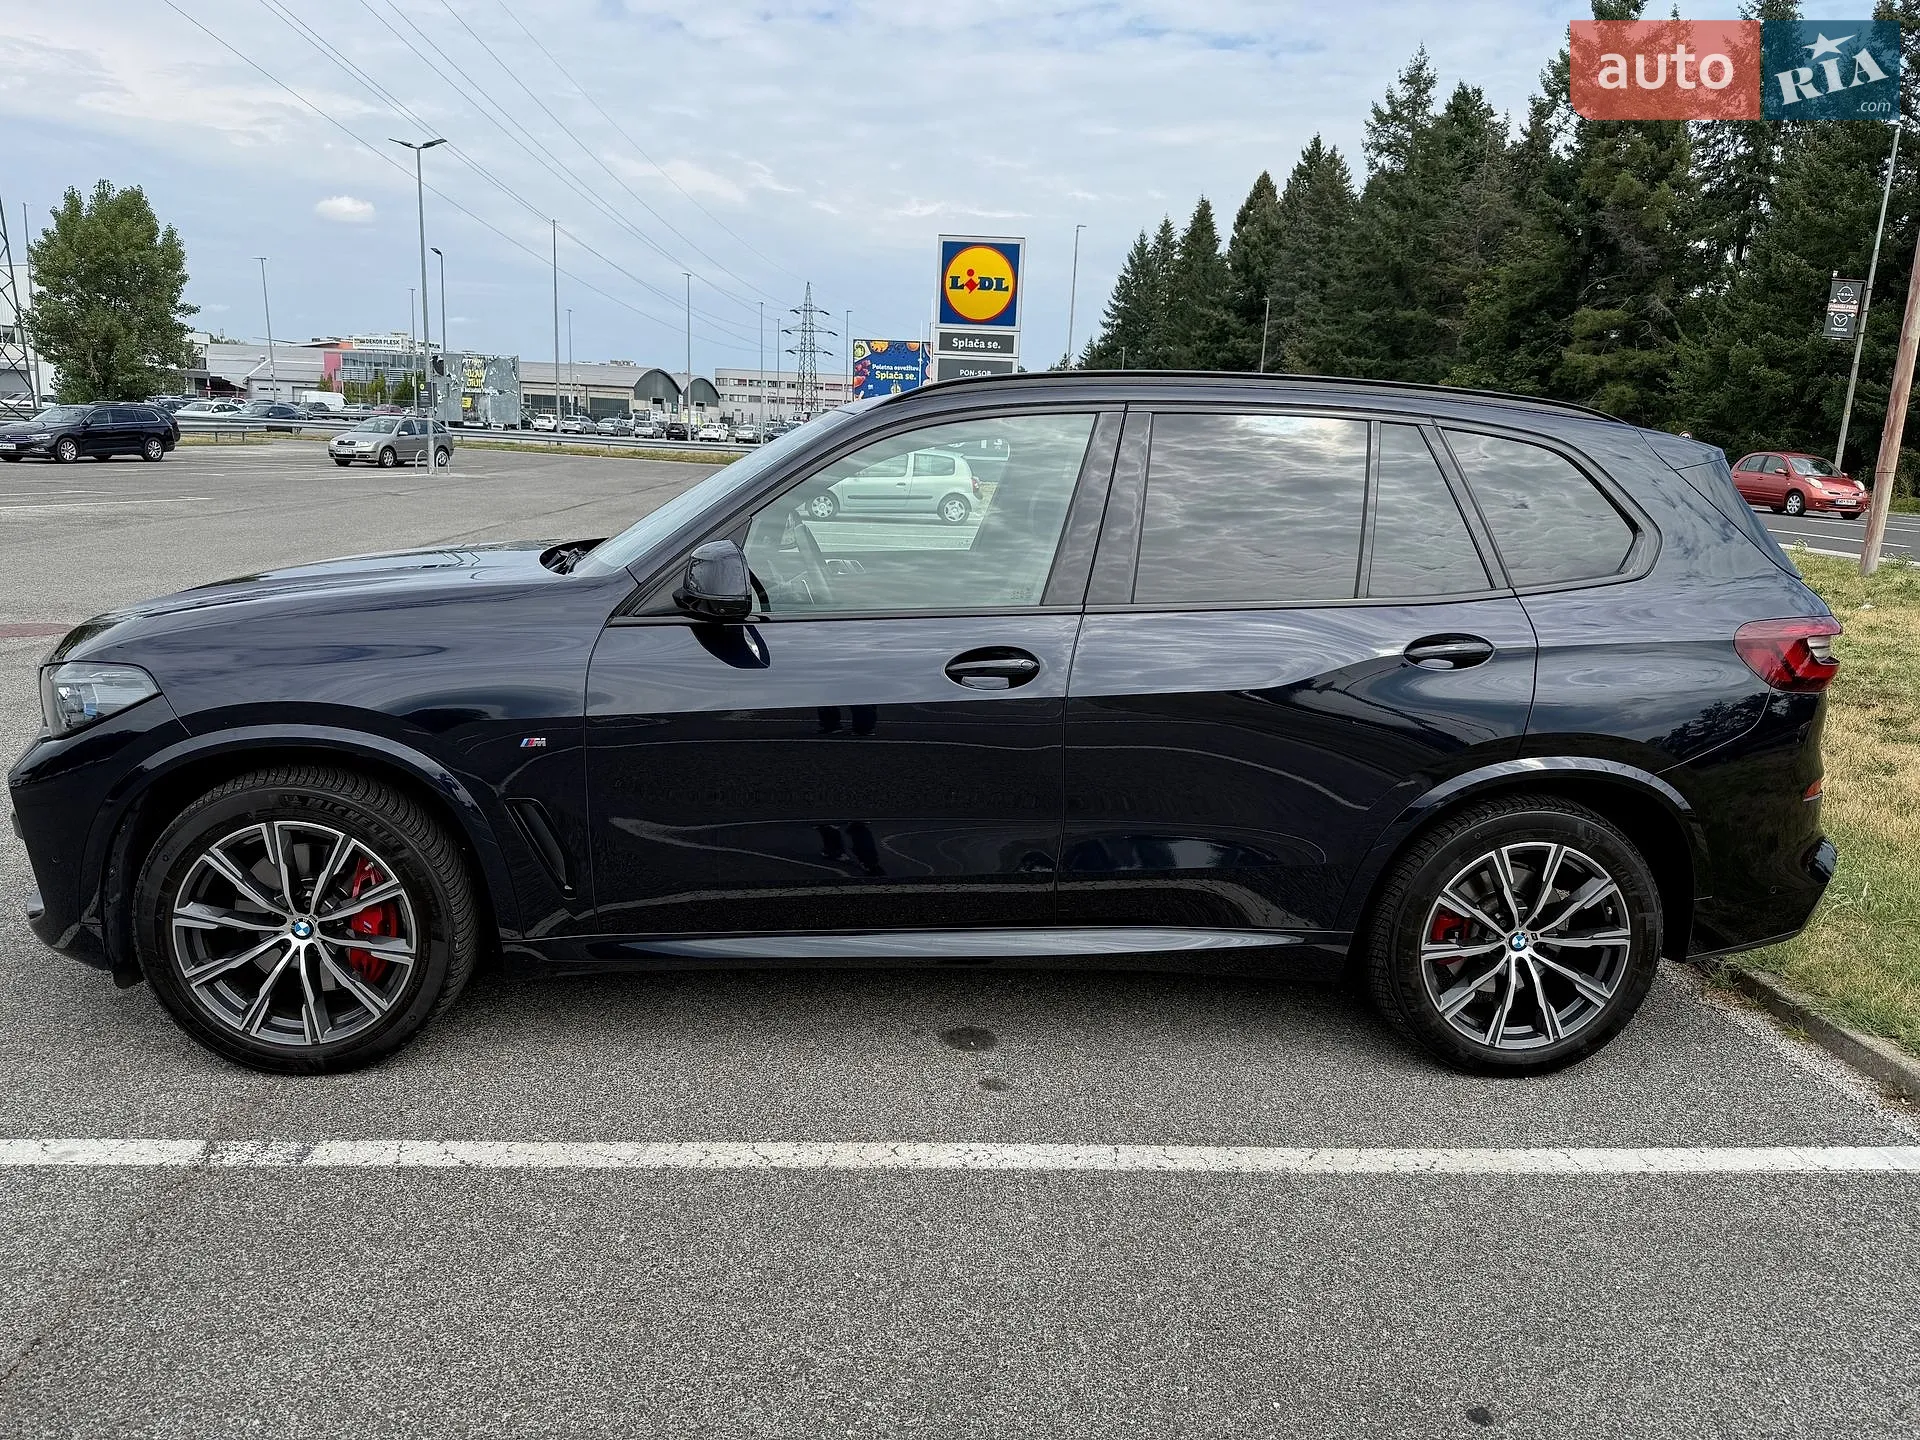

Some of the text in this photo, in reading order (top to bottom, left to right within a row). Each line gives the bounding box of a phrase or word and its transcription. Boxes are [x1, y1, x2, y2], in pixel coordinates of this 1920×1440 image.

[952, 337, 1001, 350] Splača se.
[872, 363, 893, 371] Poletna
[875, 370, 917, 381] Splača se.
[306, 796, 402, 852] MICHELIN
